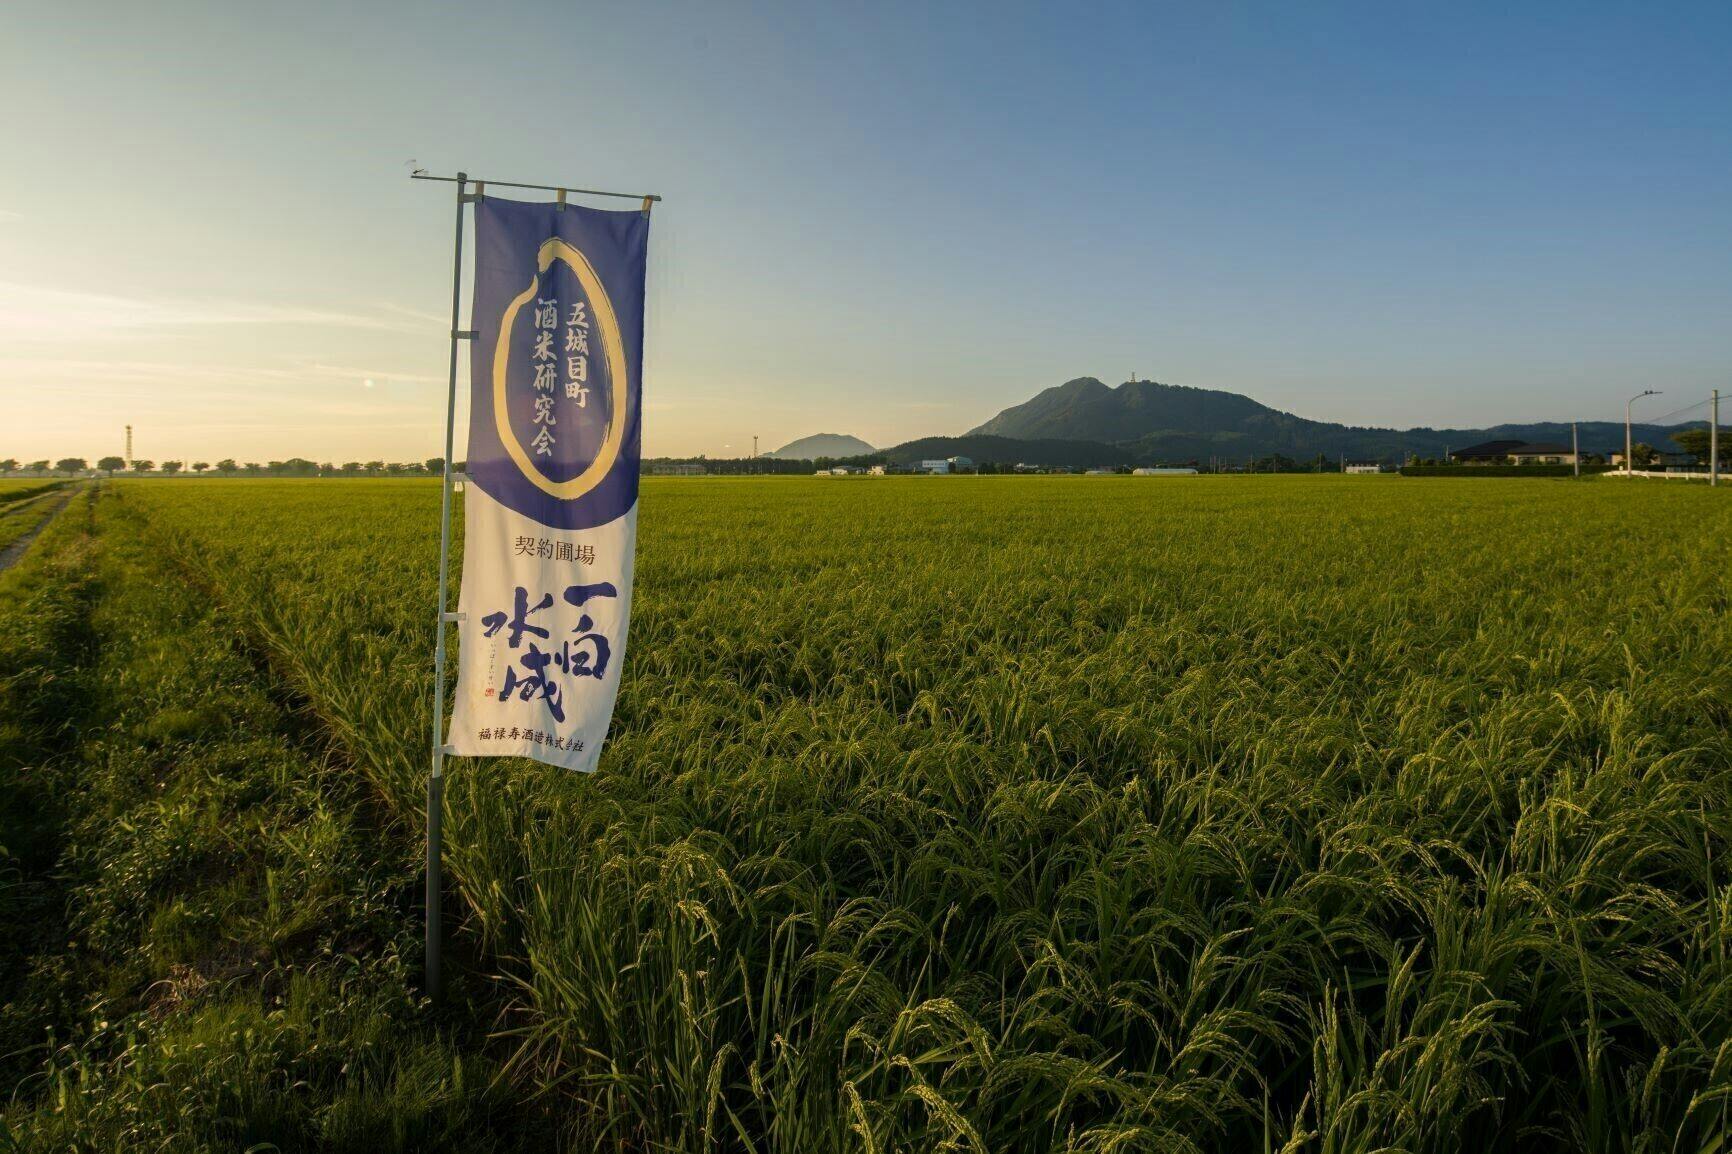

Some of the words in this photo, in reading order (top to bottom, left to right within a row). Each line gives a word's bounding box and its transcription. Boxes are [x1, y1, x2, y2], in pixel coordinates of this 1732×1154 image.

[531, 298, 558, 457] 酒米研究会
[565, 302, 590, 408] 五城目町
[515, 536, 596, 565] 契約圃場
